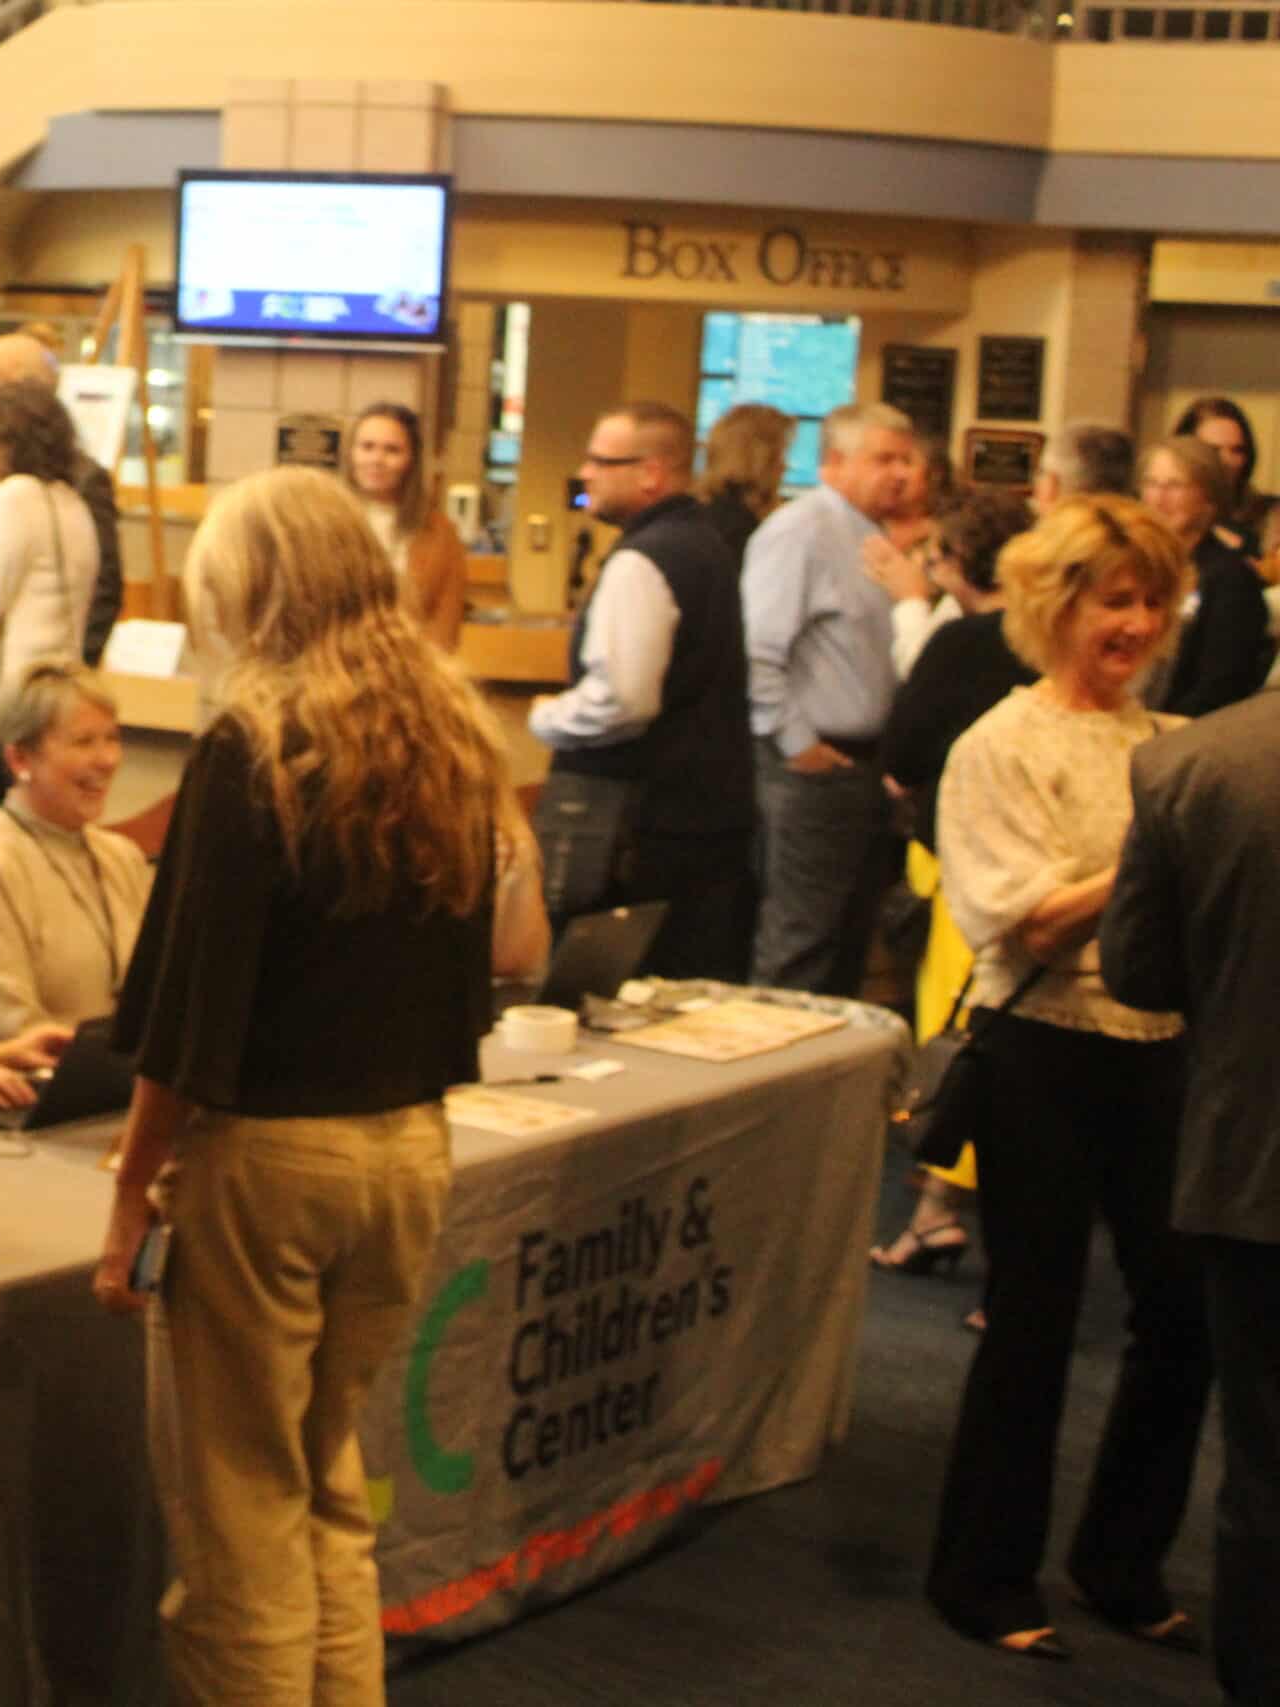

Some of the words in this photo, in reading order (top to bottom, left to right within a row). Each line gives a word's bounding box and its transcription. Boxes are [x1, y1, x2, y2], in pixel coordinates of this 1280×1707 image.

[515, 1198, 673, 1310] Family
[679, 1176, 712, 1250] &
[509, 1255, 734, 1397] Children's
[503, 1370, 662, 1480] Center
